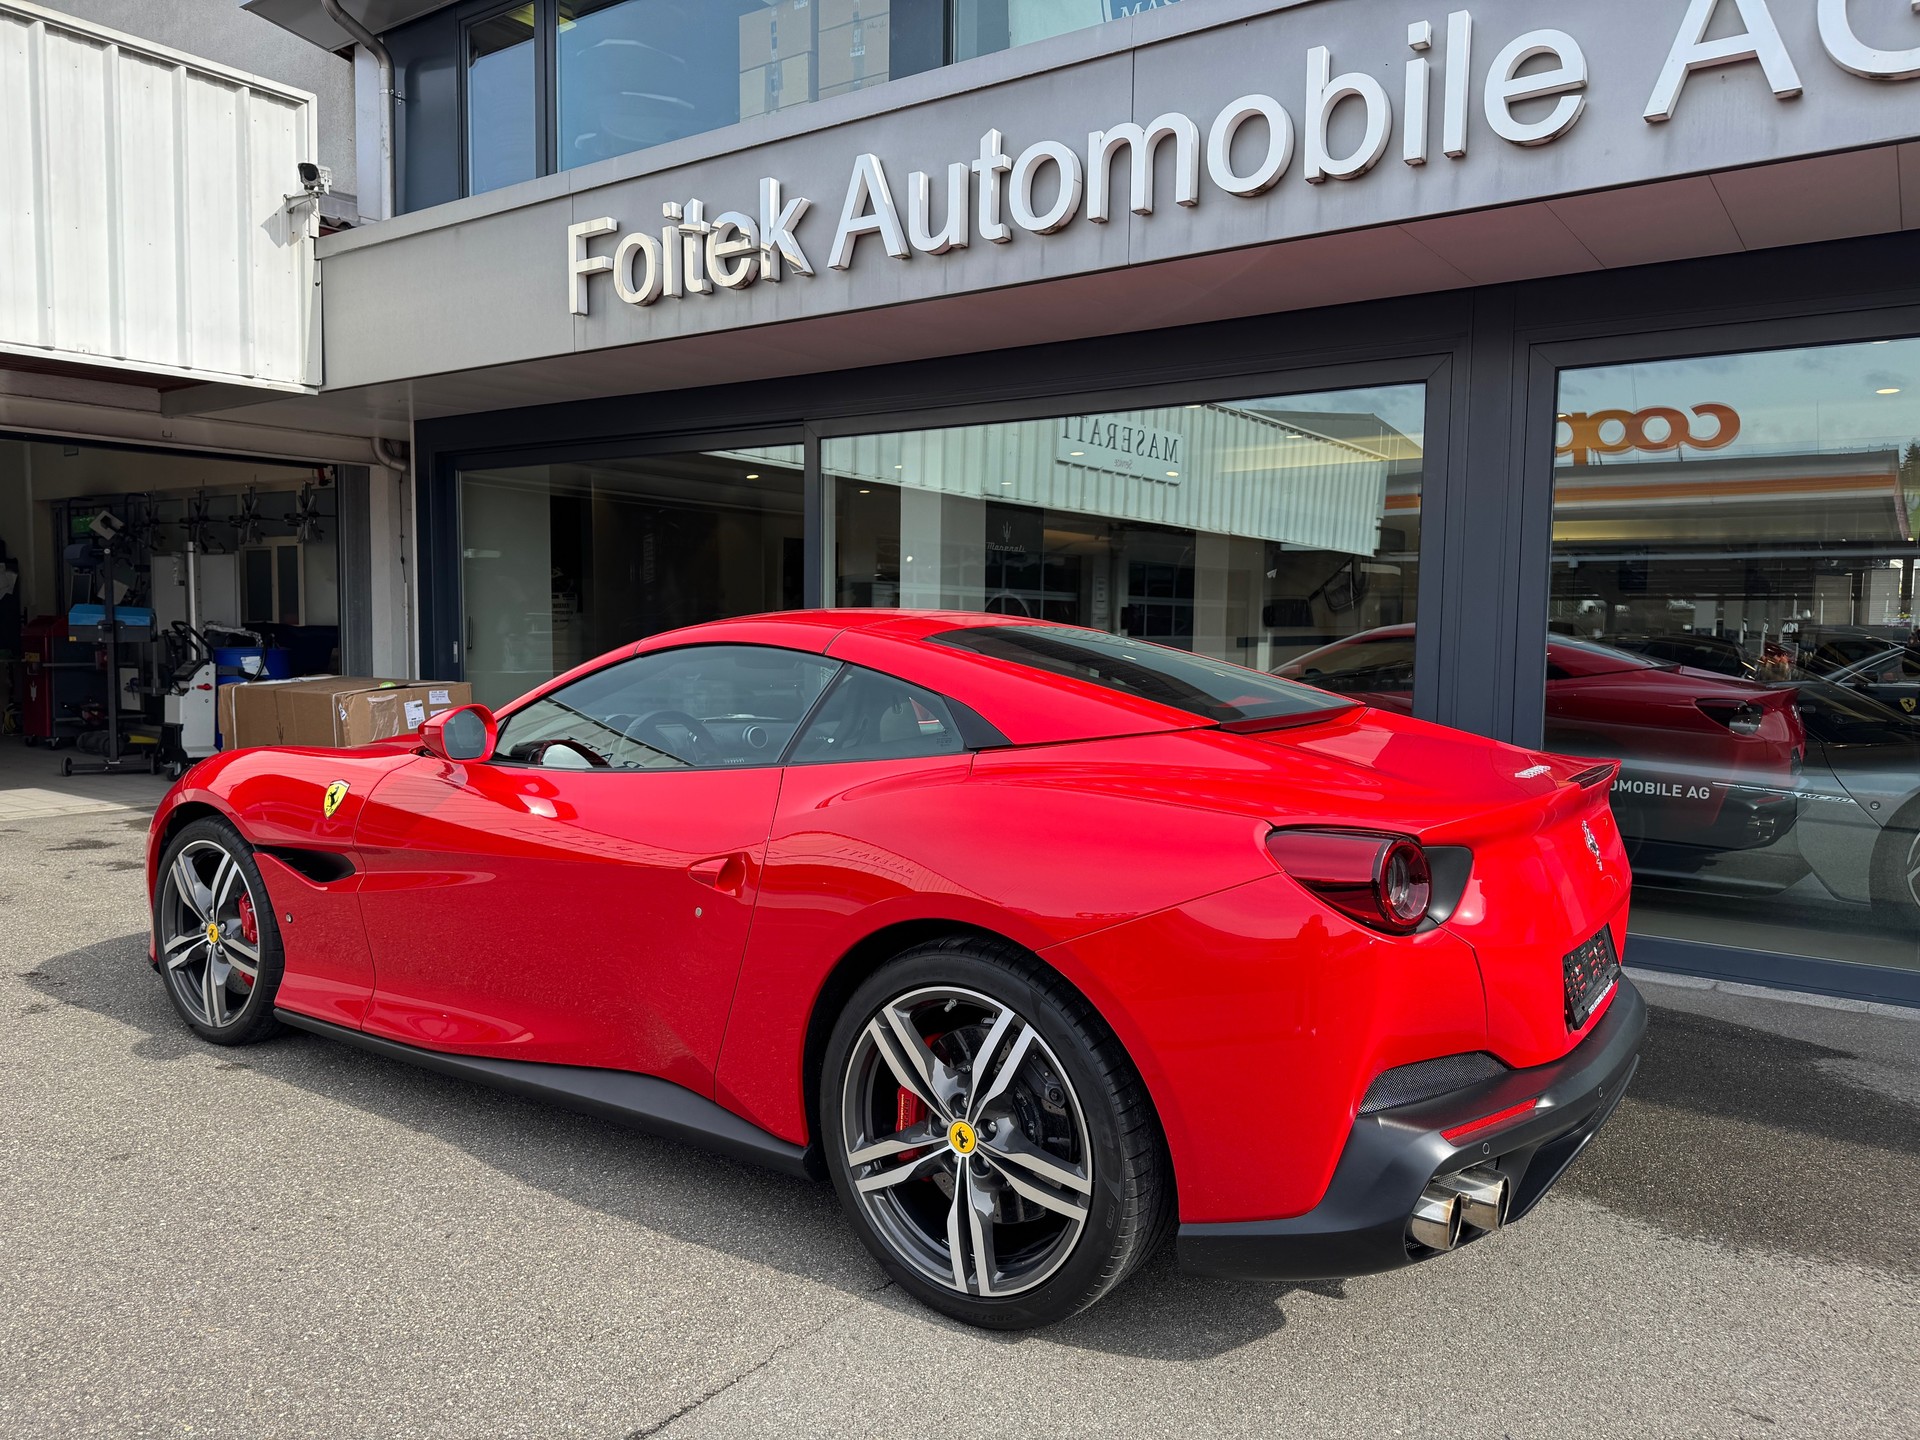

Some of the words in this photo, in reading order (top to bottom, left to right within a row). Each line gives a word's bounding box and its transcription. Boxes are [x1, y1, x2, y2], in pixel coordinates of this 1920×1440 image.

[567, 176, 814, 316] Foitek
[827, 9, 1588, 271] Automobile
[1686, 785, 1710, 800] AG
